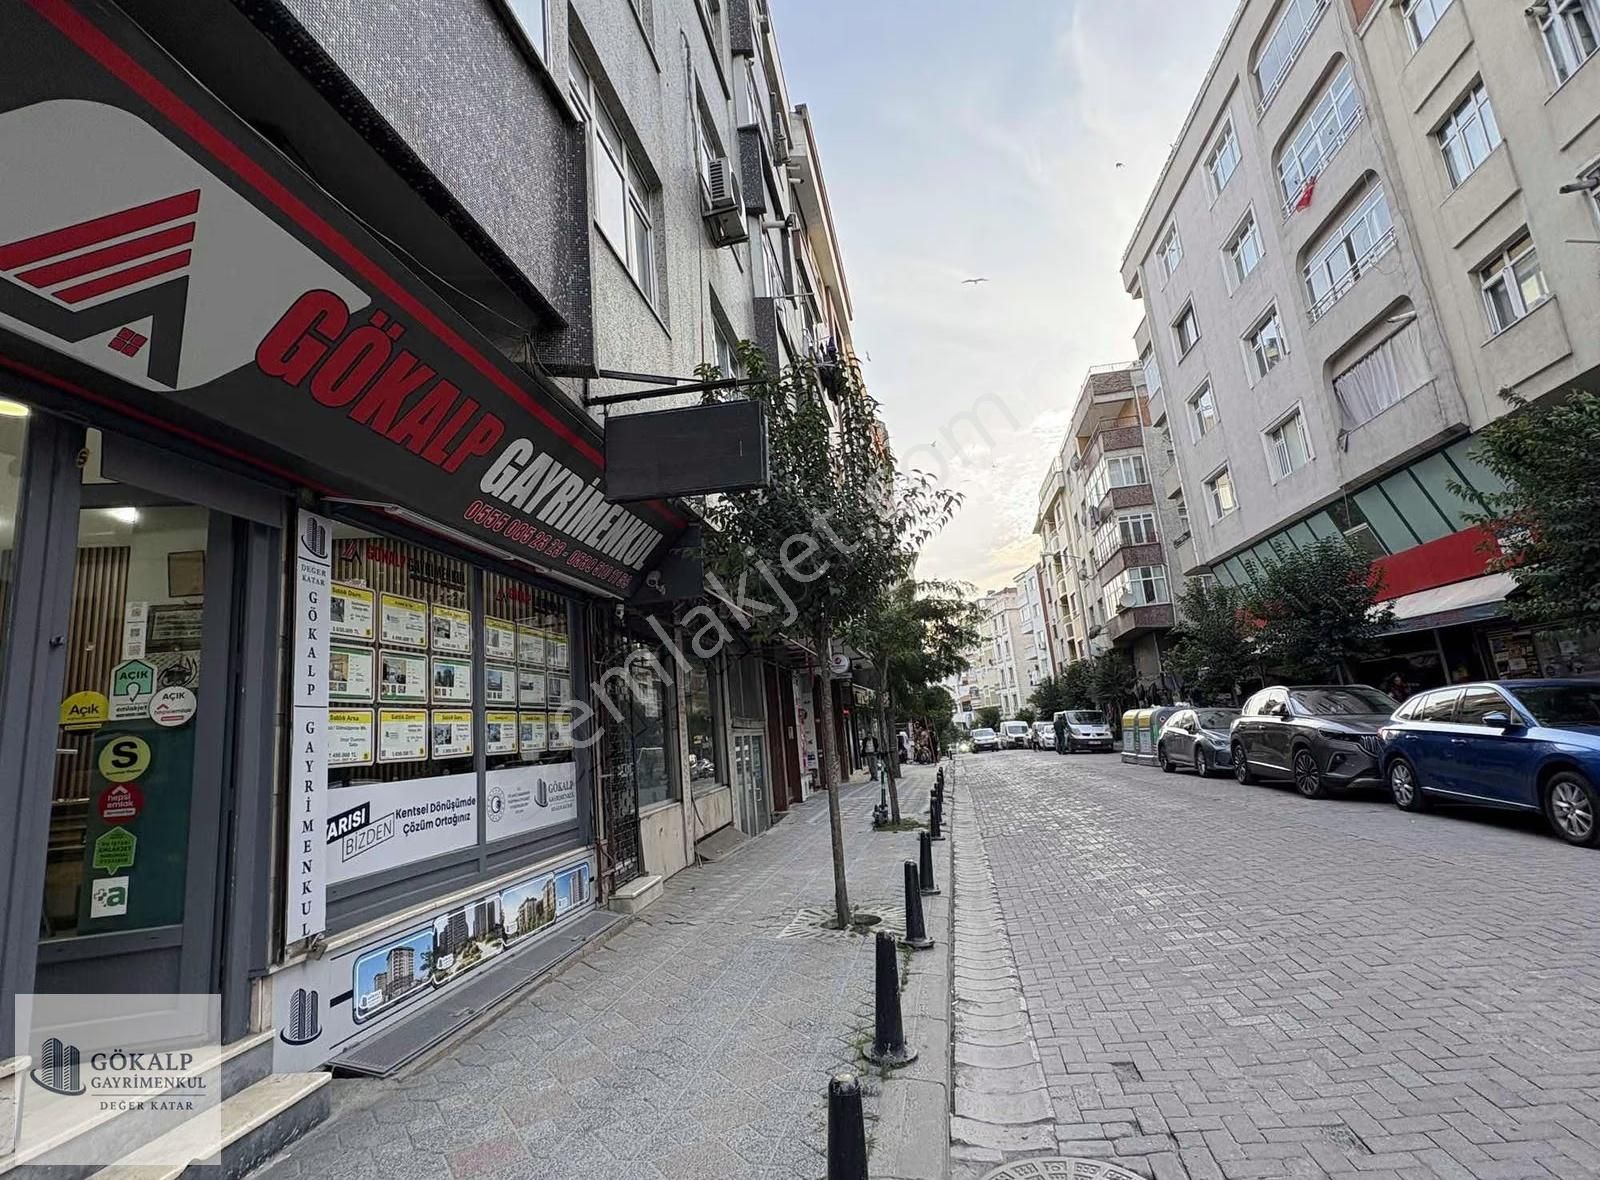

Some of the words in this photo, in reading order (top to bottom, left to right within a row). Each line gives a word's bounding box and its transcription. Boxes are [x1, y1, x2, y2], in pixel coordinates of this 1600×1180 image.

[255, 288, 505, 473] GÖKALP
[479, 438, 663, 571] GAYRİMENKUL
[463, 500, 511, 532] 0555
[503, 519, 537, 545] 085
[528, 531, 552, 552] 23
[302, 575, 325, 586] KATAR
[306, 592, 319, 696] GÖKALP
[119, 670, 148, 681] AÇIK
[162, 691, 186, 701] AÇIK
[69, 703, 99, 716] Açık
[111, 741, 138, 768] S
[548, 780, 574, 794] GÖKALP
[395, 802, 429, 819] Kentsel
[430, 796, 476, 813] Dönüşümde
[301, 721, 315, 937] GAYRİMENKUL
[402, 820, 433, 837] Çözüm
[435, 813, 471, 827] Ortağınız
[346, 819, 392, 856] BİZDEN
